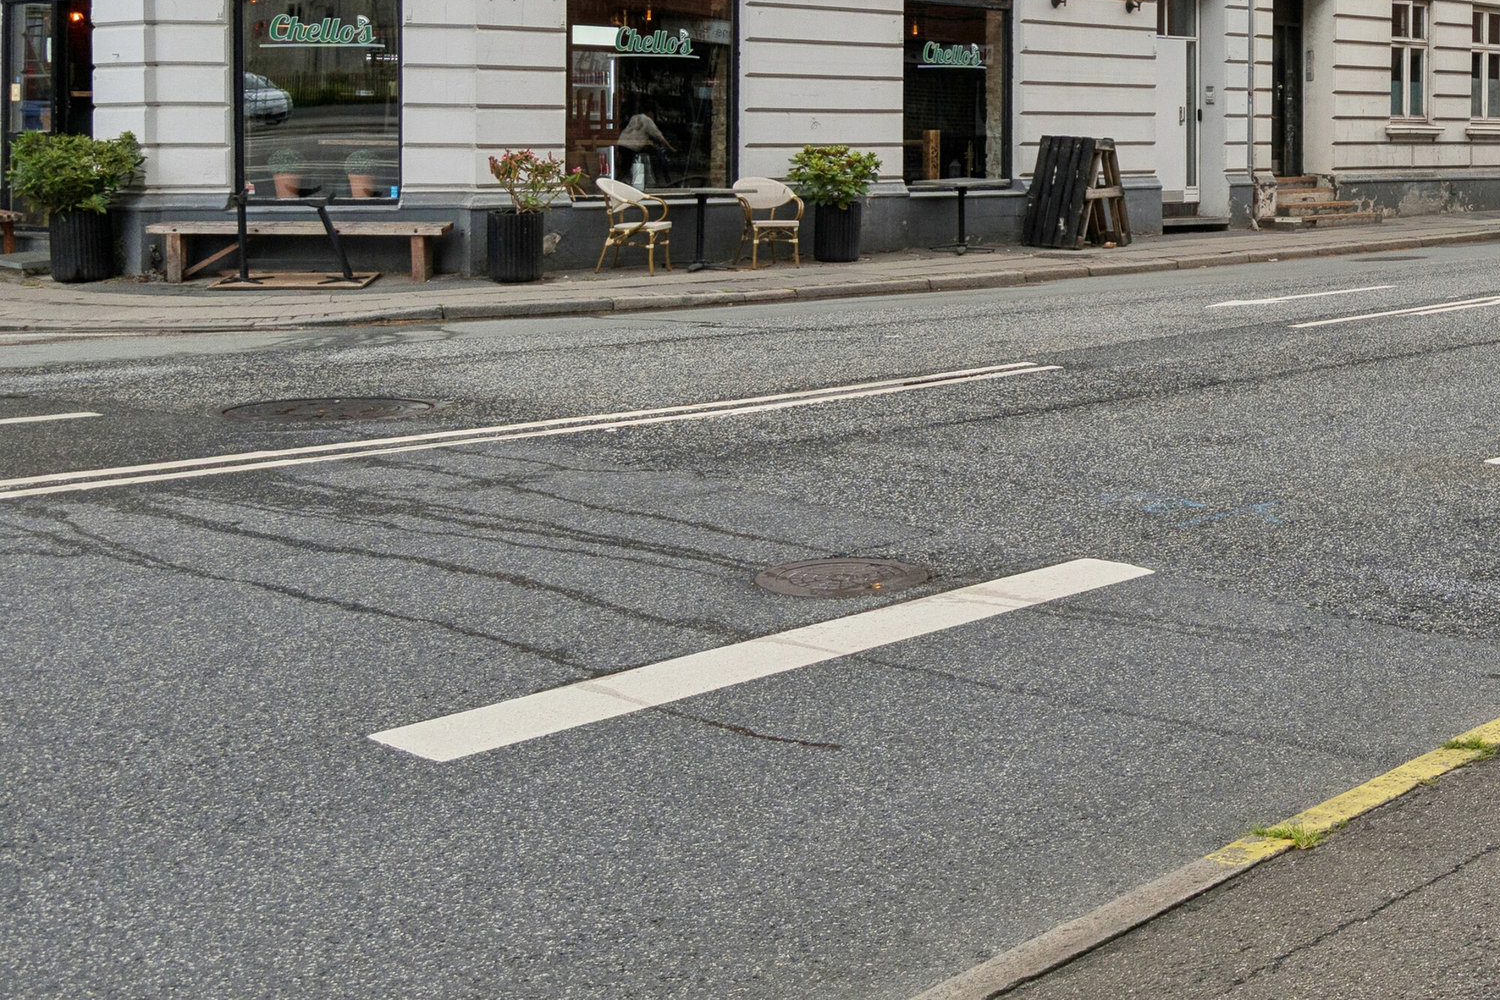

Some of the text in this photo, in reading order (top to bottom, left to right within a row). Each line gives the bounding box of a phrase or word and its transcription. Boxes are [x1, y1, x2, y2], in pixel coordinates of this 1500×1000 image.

[269, 14, 376, 45] Chello's
[615, 25, 694, 55] Chello's
[922, 40, 982, 67] Chello's
